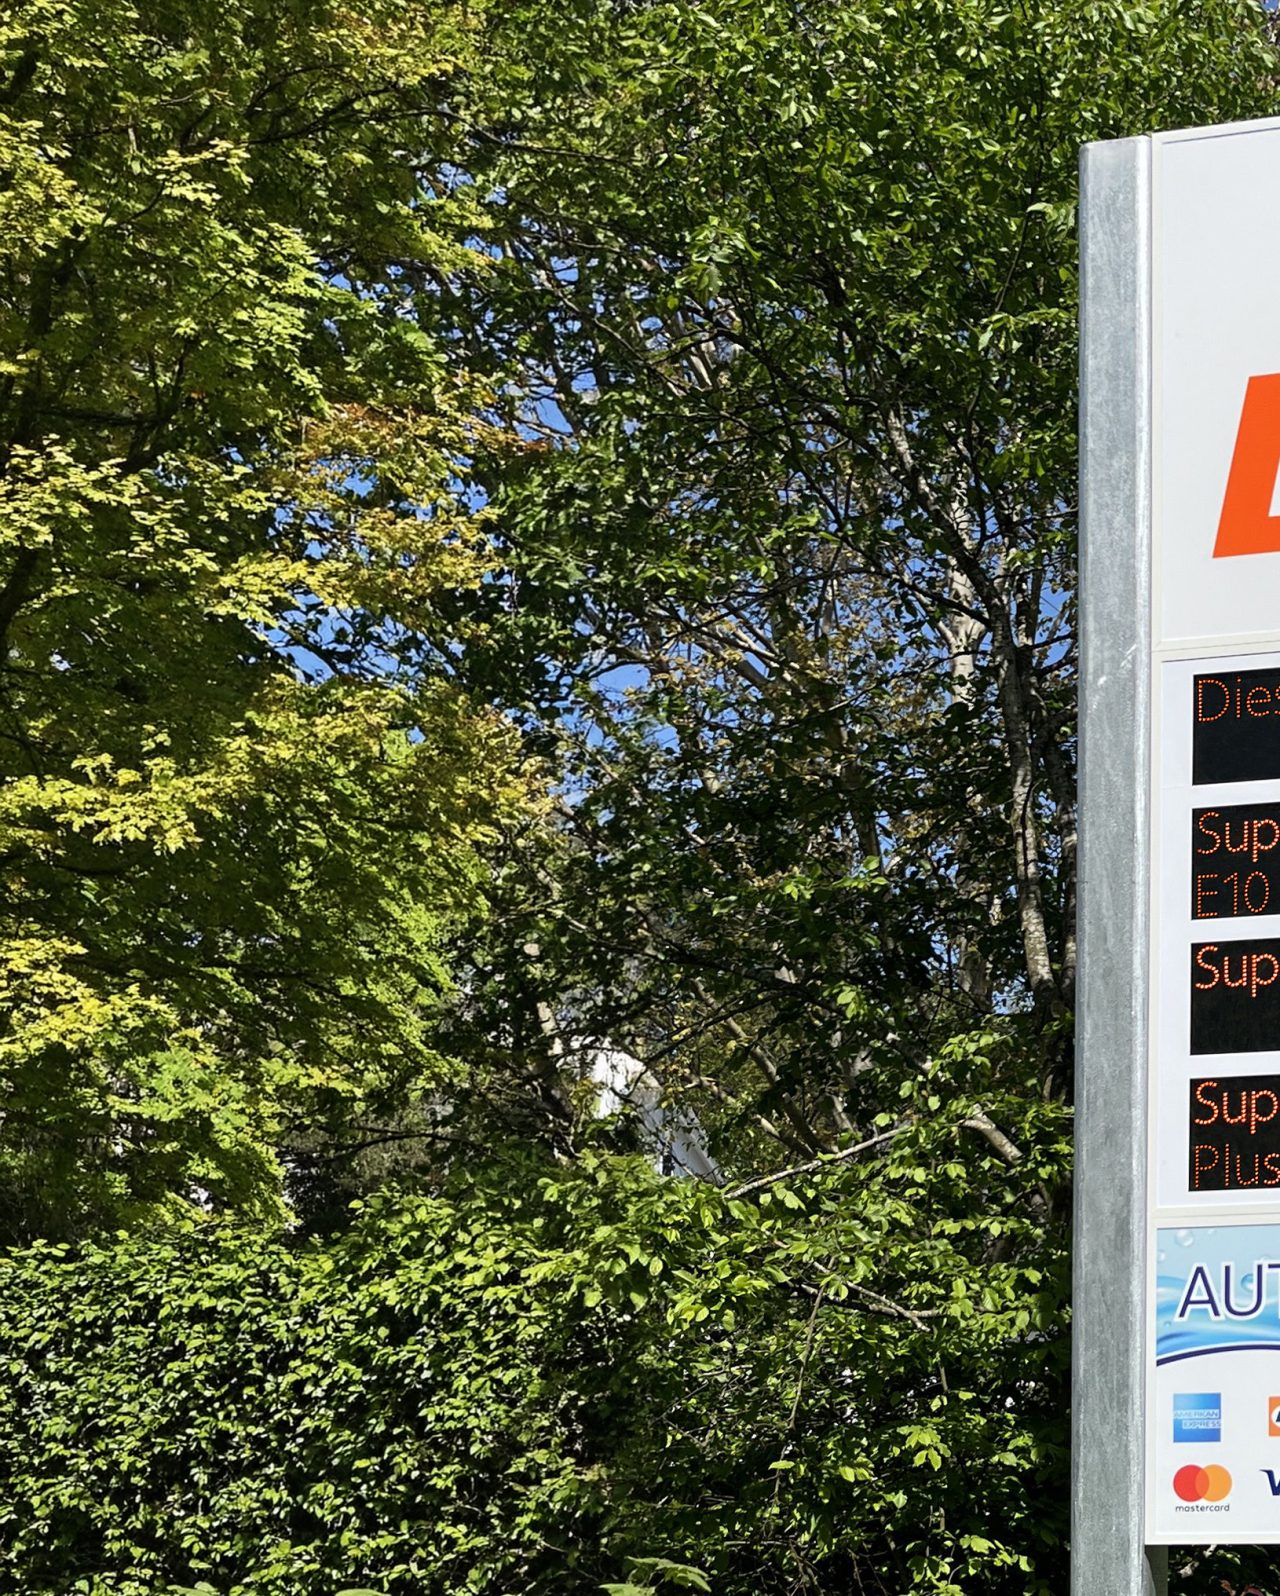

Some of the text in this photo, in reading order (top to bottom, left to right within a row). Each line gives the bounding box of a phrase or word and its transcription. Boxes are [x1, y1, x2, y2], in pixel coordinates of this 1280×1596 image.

[1196, 870, 1271, 917] E10
[1173, 1409, 1220, 1419] AMERICAN
[1182, 1419, 1221, 1429] EXPRESS
[1175, 1503, 1231, 1513] mastercard
